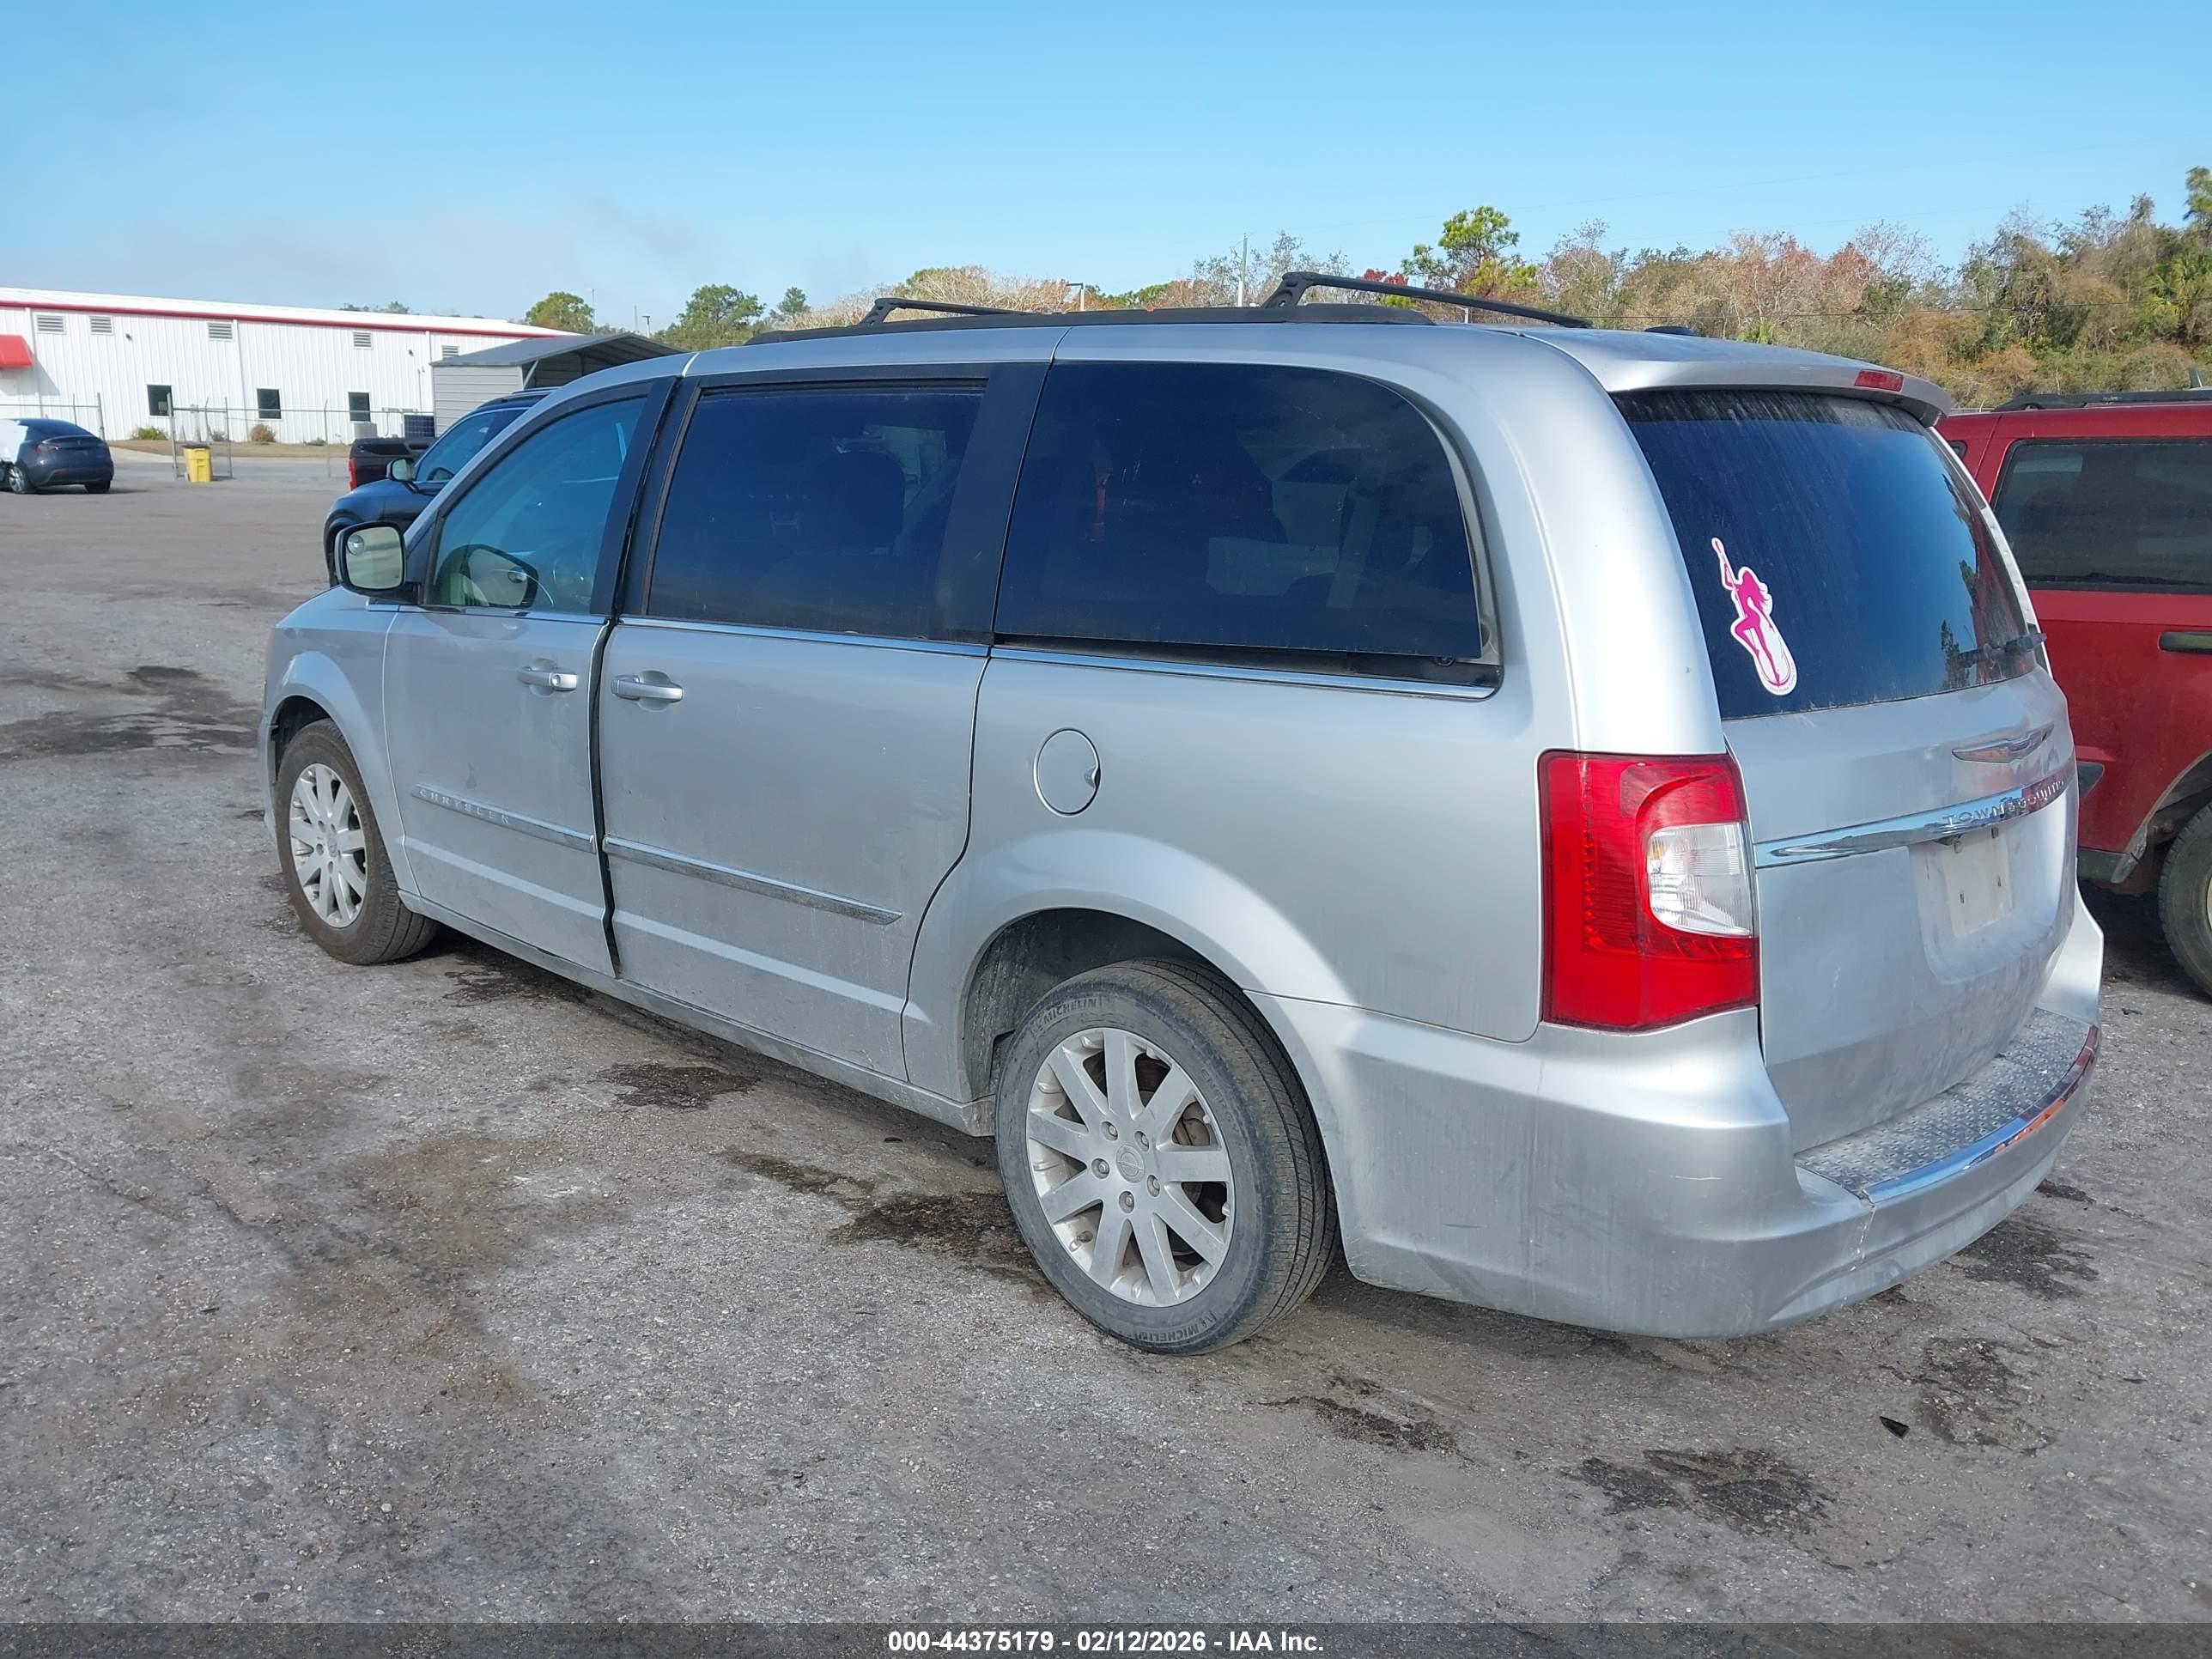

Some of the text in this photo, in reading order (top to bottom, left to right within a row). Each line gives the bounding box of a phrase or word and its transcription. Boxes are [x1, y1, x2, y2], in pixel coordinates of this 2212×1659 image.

[419, 789, 509, 825] CHRYSLER
[1042, 996, 1099, 1025] MICHELIN
[1138, 1323, 1200, 1342] MICHELIN
